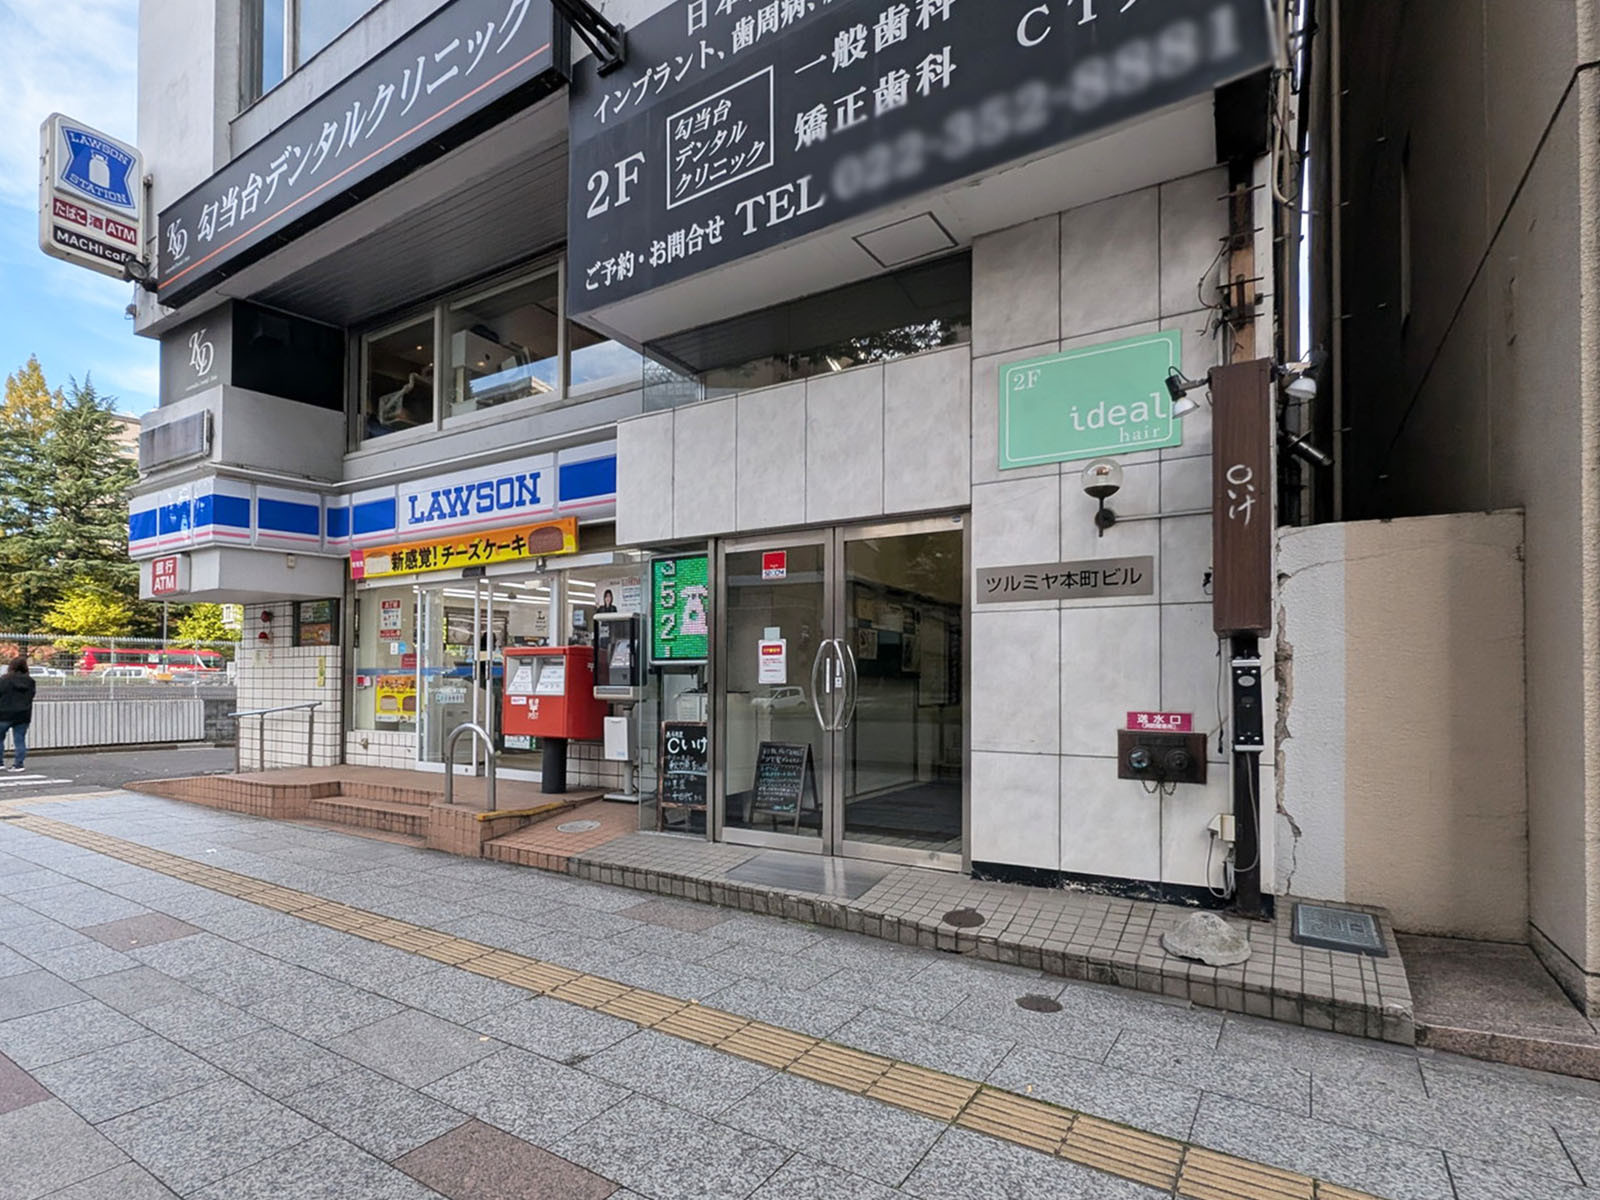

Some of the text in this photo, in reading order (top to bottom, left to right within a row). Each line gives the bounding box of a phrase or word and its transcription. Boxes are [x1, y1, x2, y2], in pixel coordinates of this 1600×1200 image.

[794, 0, 957, 74] 一般歯科
[593, 0, 833, 125] インプラント、歯周病、
[794, 46, 957, 151] 矯正歯科
[197, 0, 531, 242] 勾当台デンタルクリニック
[675, 99, 731, 141] 勾当台
[69, 131, 129, 166] LAWSON
[675, 121, 748, 172] デンタル
[68, 173, 128, 204] STATION
[586, 151, 646, 219] 2F
[675, 140, 766, 198] クリニック
[55, 201, 86, 224] たばこ
[106, 222, 136, 243] ATM
[734, 174, 826, 236] TEL
[57, 230, 103, 255] MACHI
[1013, 368, 1041, 391] 2F
[1069, 392, 1166, 431] ideal
[1119, 425, 1161, 443] hair
[408, 472, 541, 525] LAWSON
[156, 560, 174, 574] 銀行
[391, 534, 527, 571] 新感覚!チーズケーキ
[154, 575, 175, 591] ATM
[985, 566, 1143, 594] ツルミヤ本町ビル
